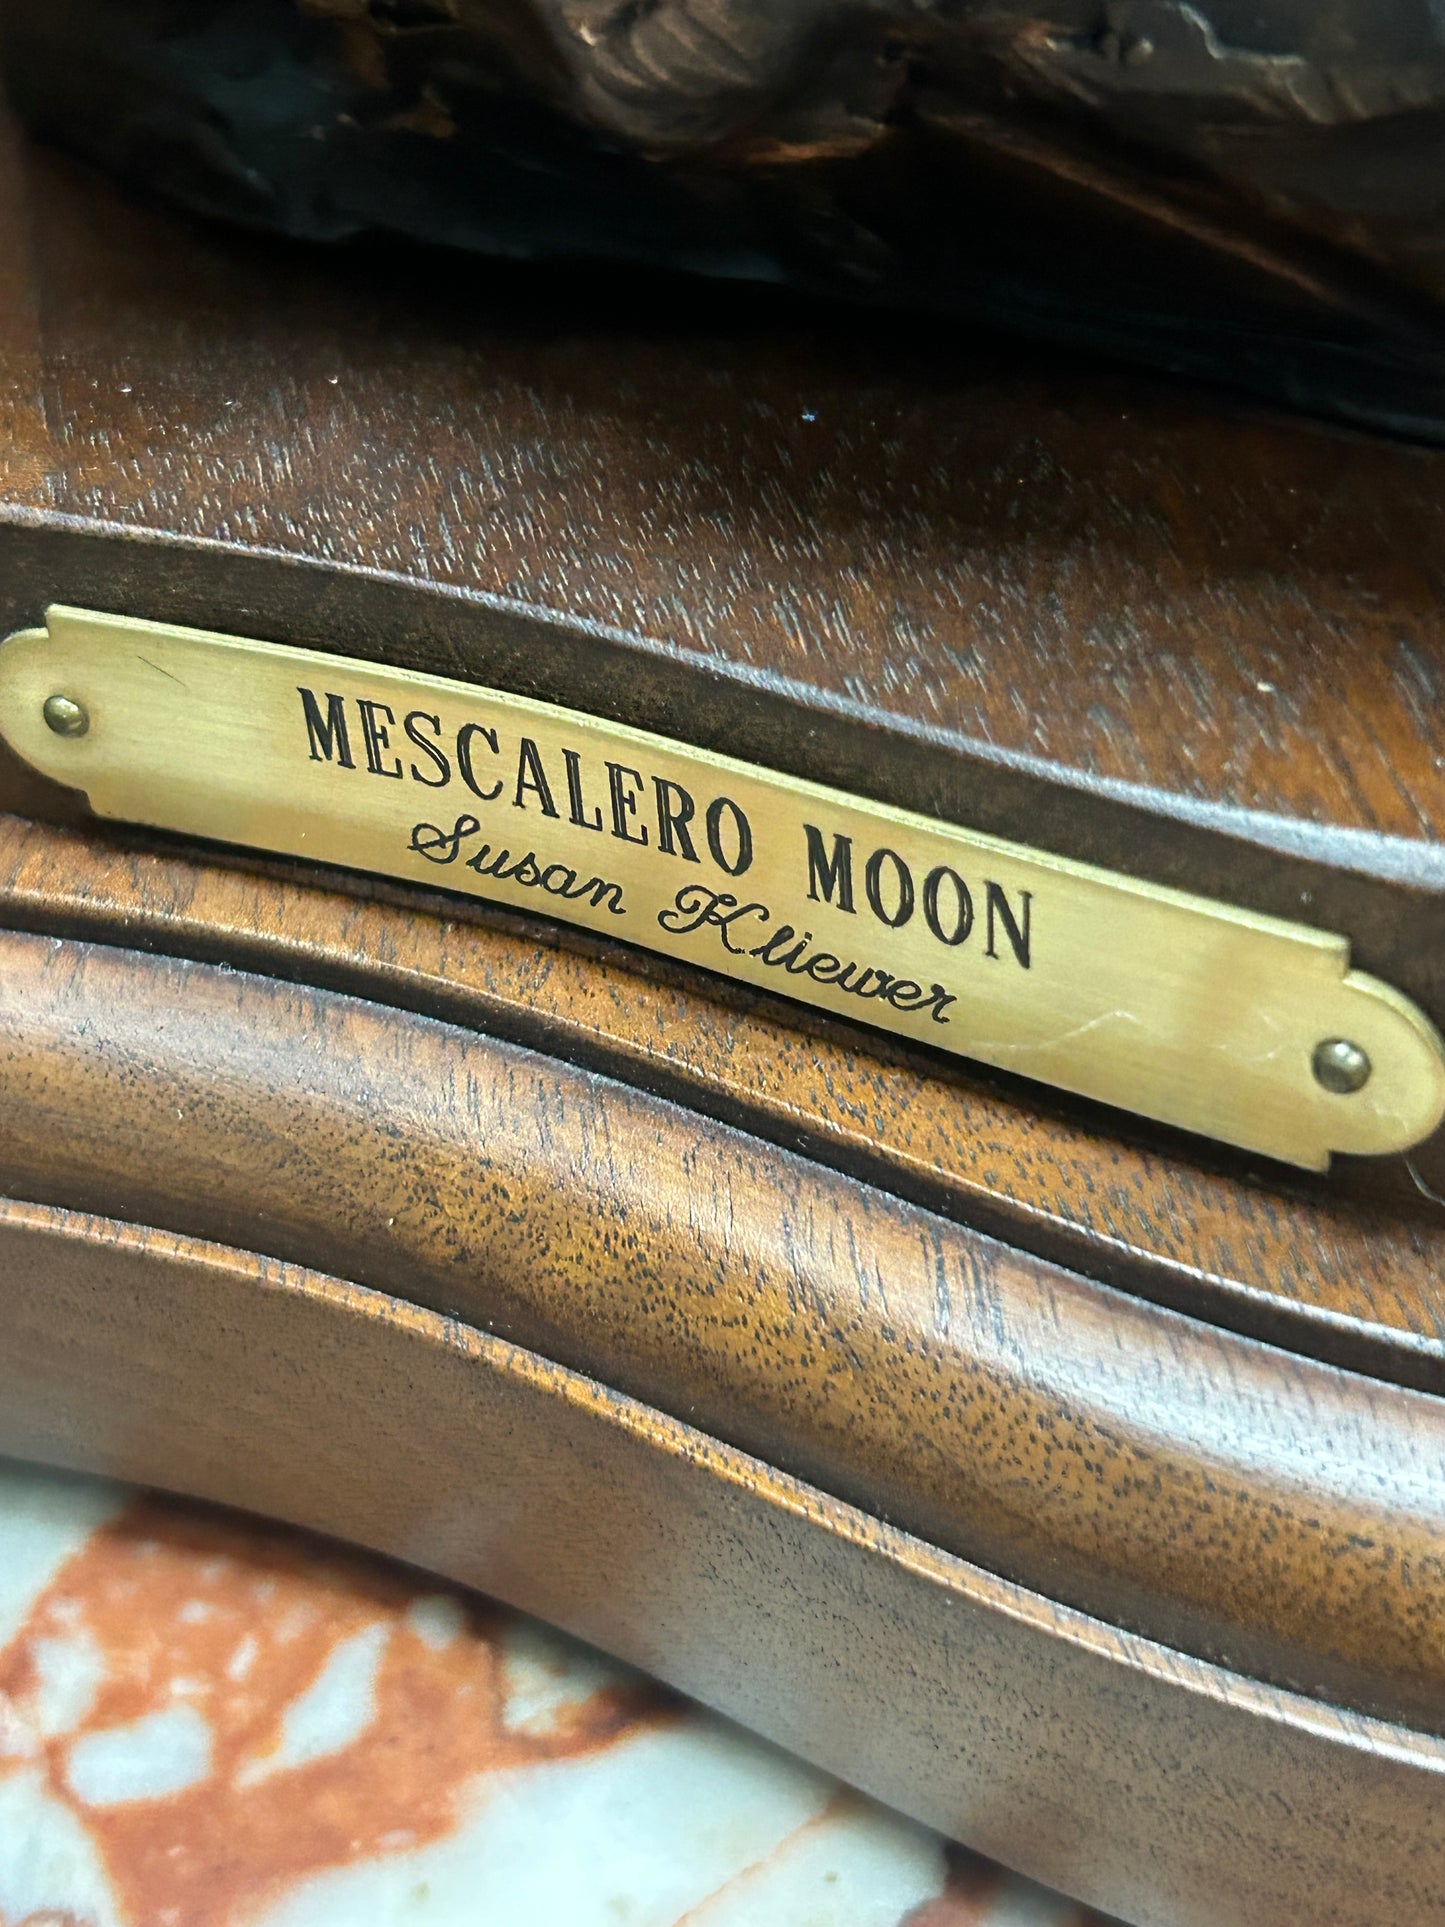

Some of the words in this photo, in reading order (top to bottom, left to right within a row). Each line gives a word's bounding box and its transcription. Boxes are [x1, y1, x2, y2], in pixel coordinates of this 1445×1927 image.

[297, 686, 754, 877] MESCALERO
[803, 823, 1035, 970] MOON
[408, 813, 627, 916] Susan
[657, 884, 958, 1024] Kliewer
